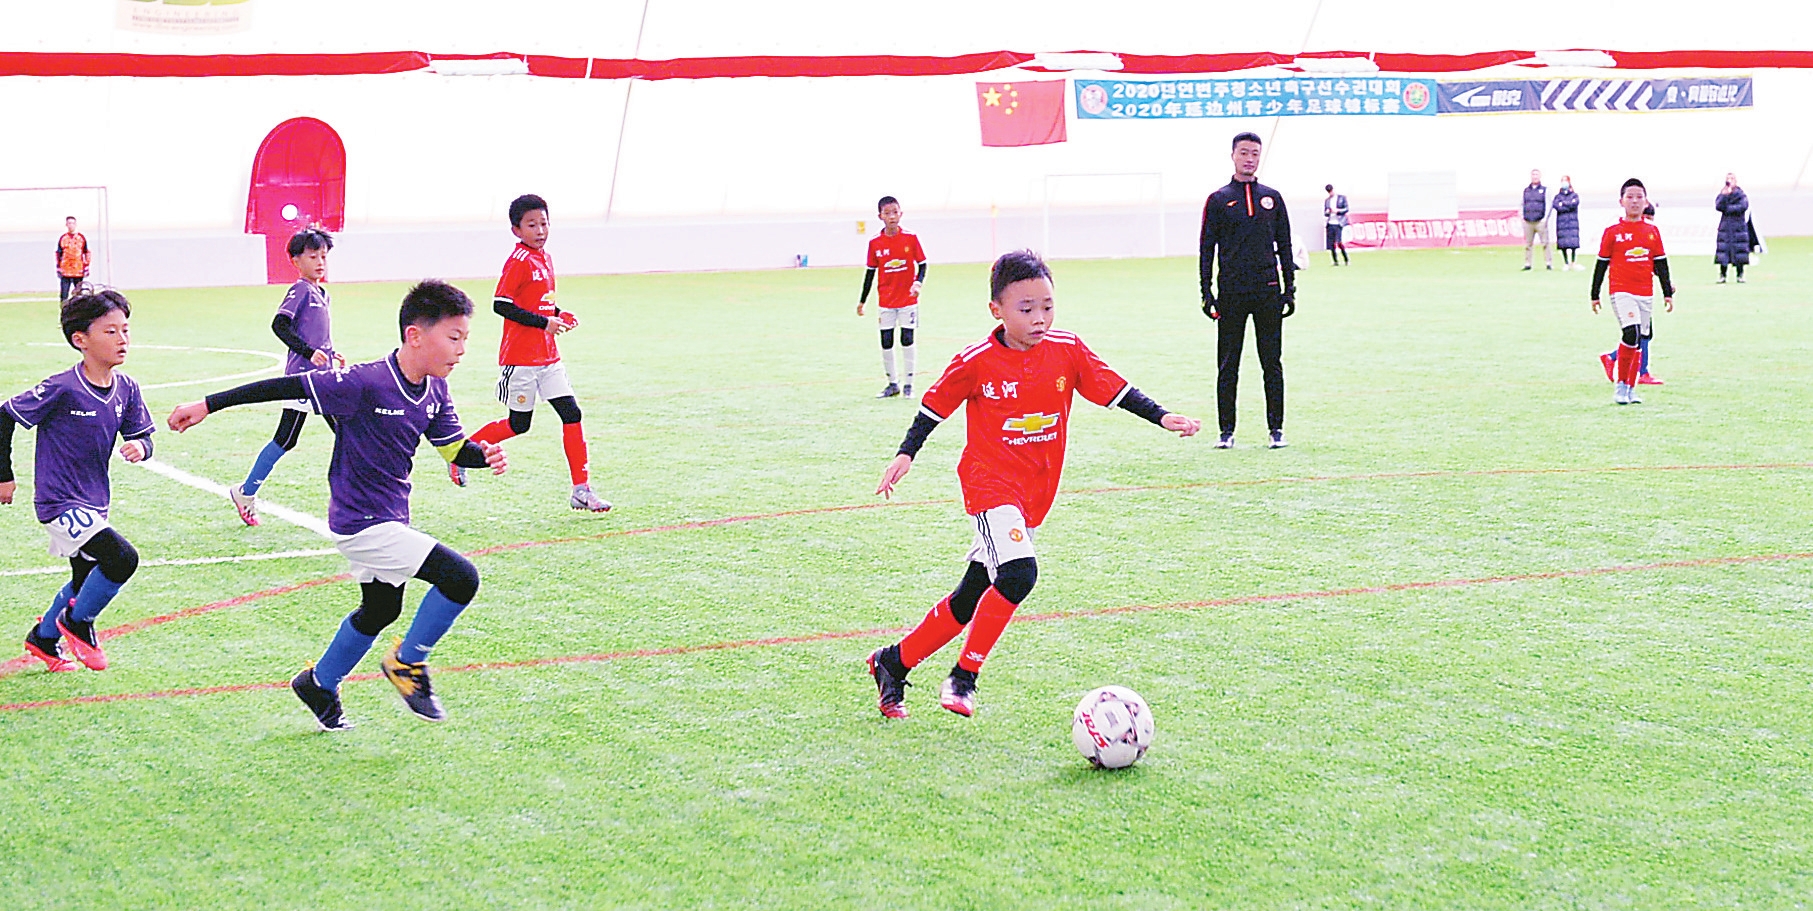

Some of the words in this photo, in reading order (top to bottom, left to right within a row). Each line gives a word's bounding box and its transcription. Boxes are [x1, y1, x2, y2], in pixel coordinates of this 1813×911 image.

[981, 380, 1019, 400] 延河
[374, 407, 406, 416] KELME
[58, 508, 94, 539] 20
